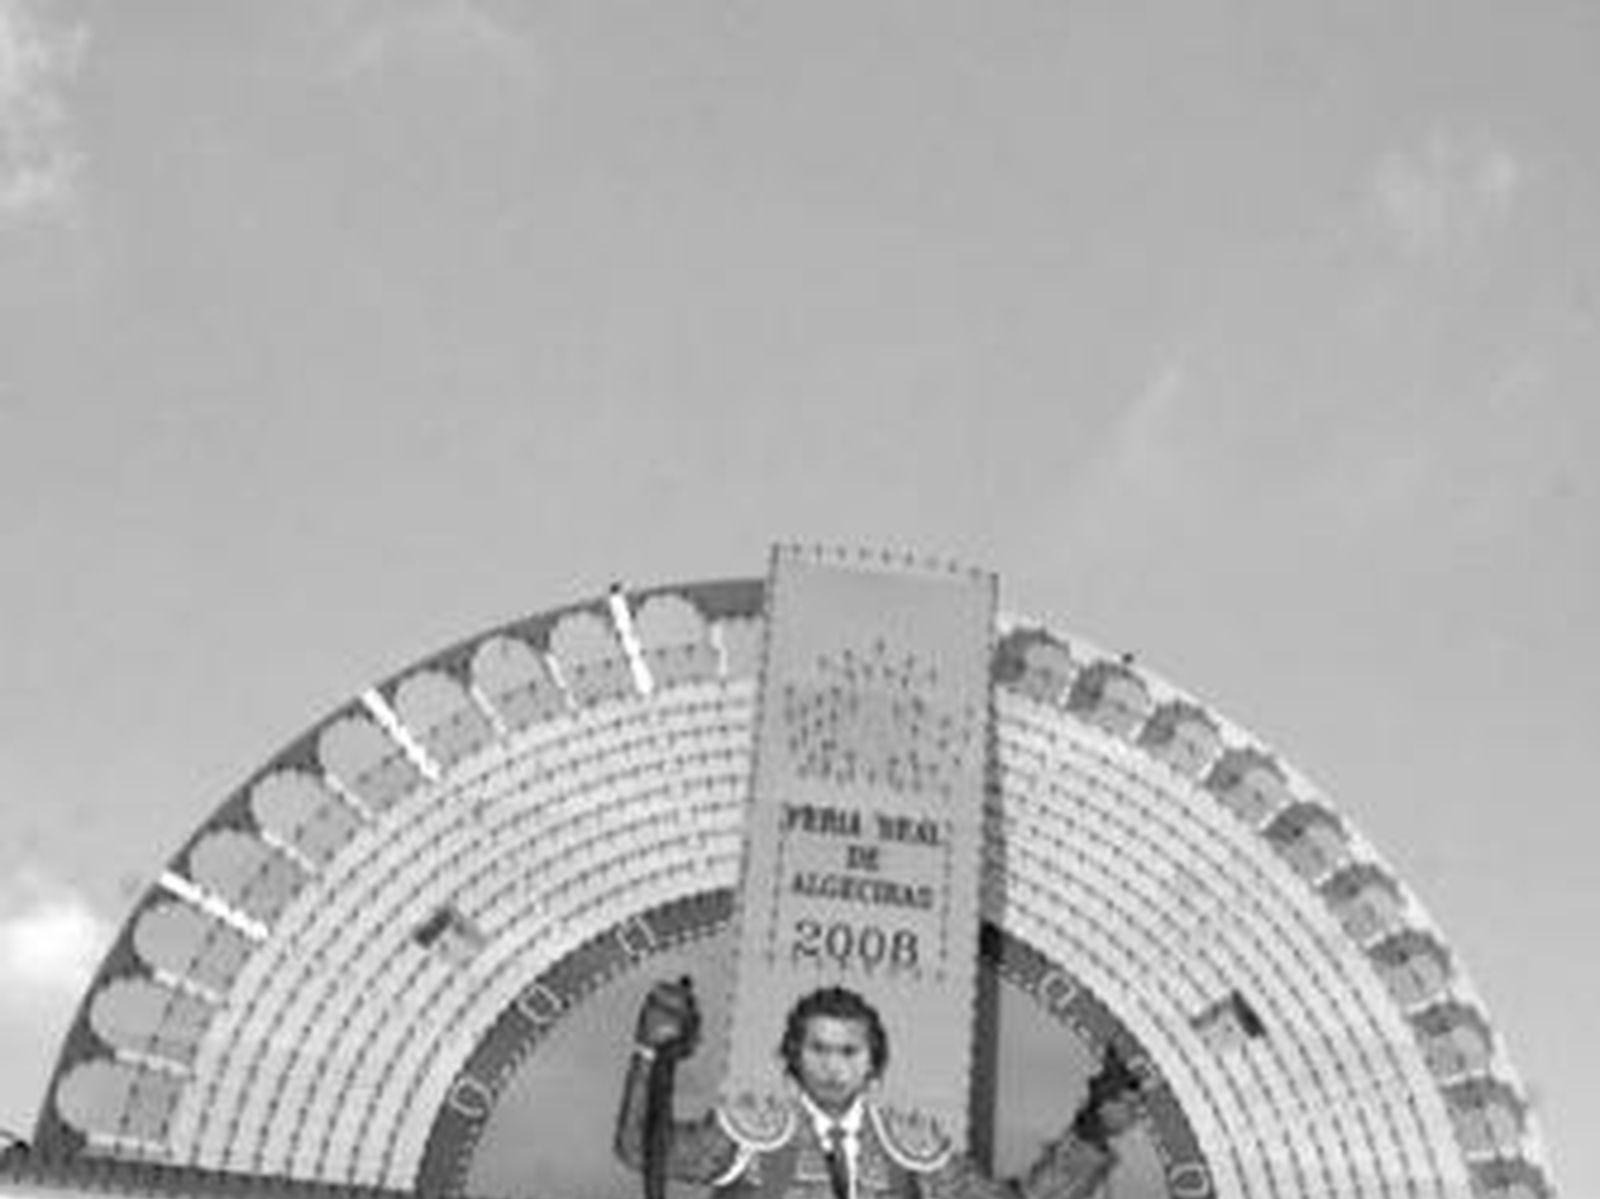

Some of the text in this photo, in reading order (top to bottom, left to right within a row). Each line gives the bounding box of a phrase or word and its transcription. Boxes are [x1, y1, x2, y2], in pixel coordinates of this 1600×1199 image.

[785, 803, 942, 846] FERIA REAL
[847, 844, 880, 872] DE
[792, 872, 934, 910] ALGECIRAS
[794, 918, 918, 967] 2008
